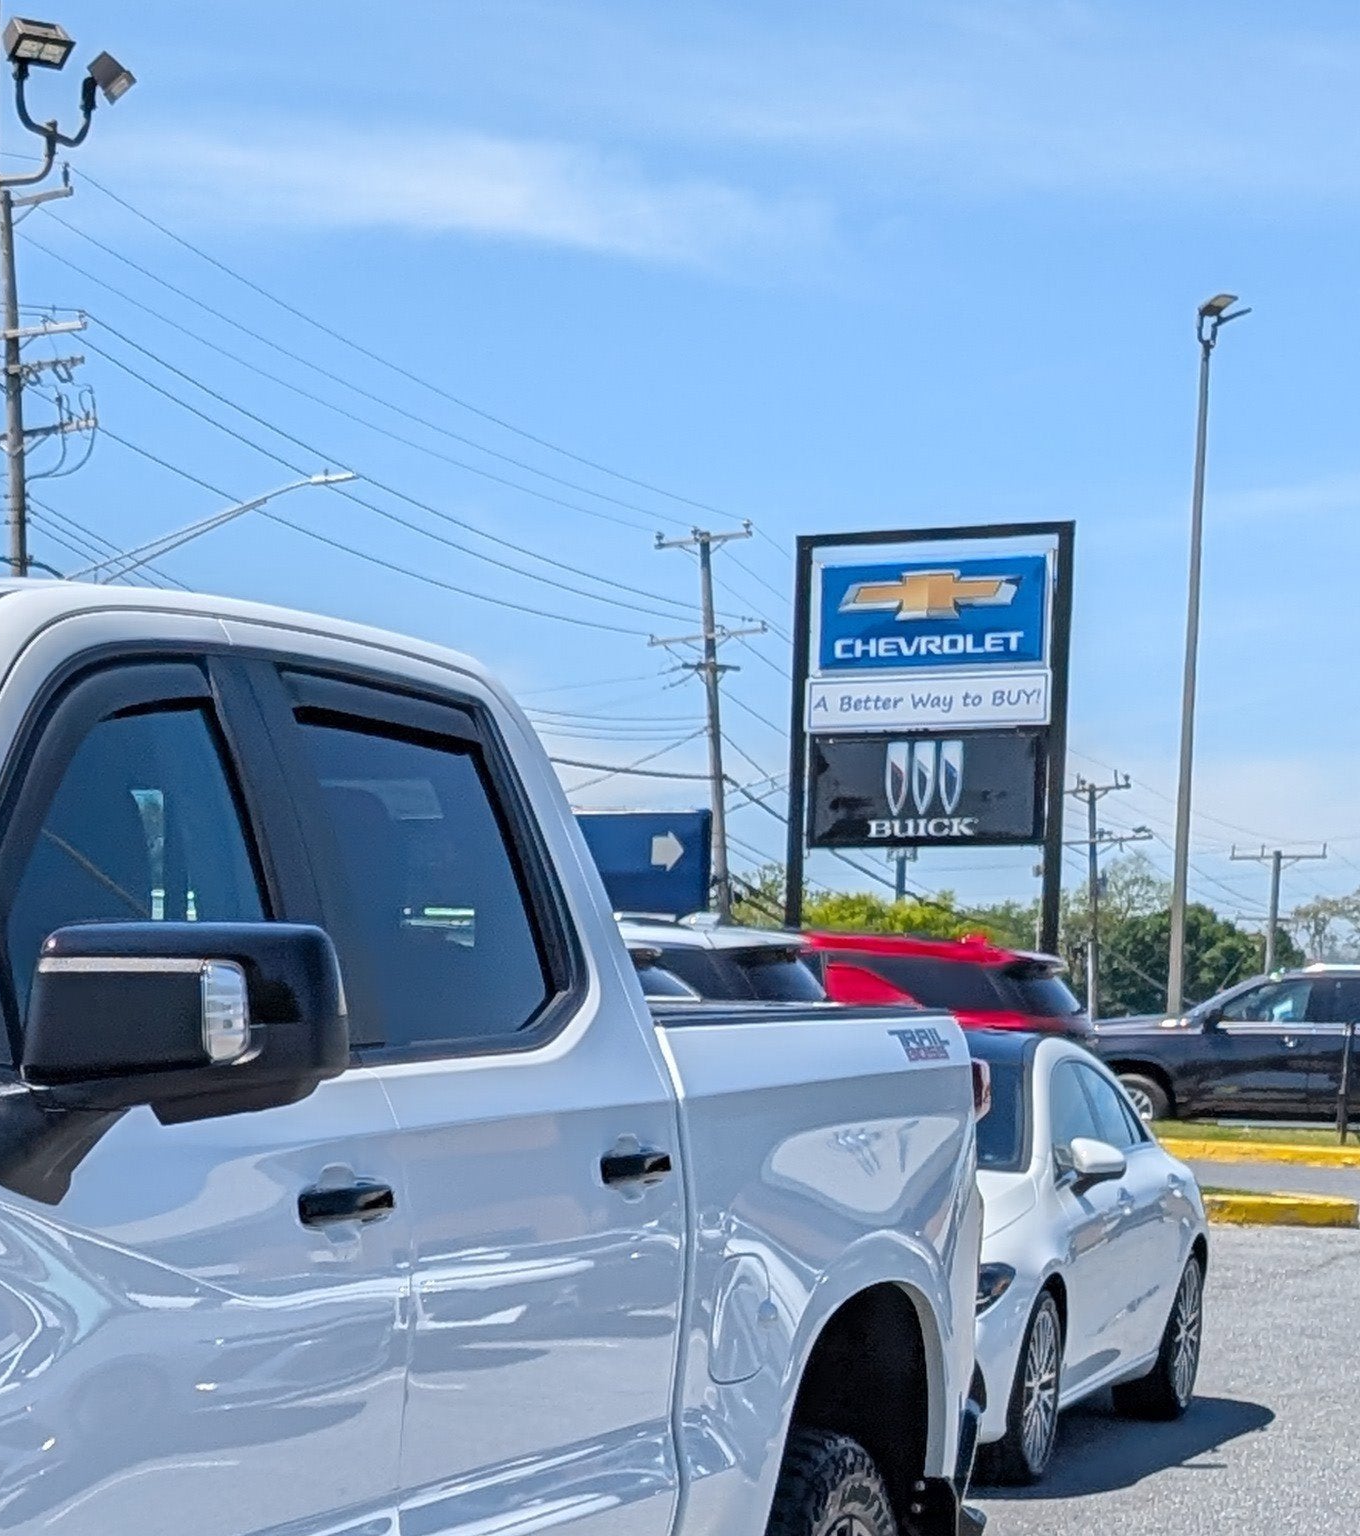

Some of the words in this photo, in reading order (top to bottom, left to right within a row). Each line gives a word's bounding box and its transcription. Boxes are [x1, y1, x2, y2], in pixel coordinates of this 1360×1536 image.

[833, 631, 1025, 660] CHEVROLET
[812, 696, 829, 712] A
[839, 694, 904, 713] Better
[910, 693, 953, 713] Way
[962, 692, 983, 708] to
[991, 688, 1042, 707] BUY!
[866, 816, 977, 839] BUICK
[887, 1028, 950, 1047] TRAIL
